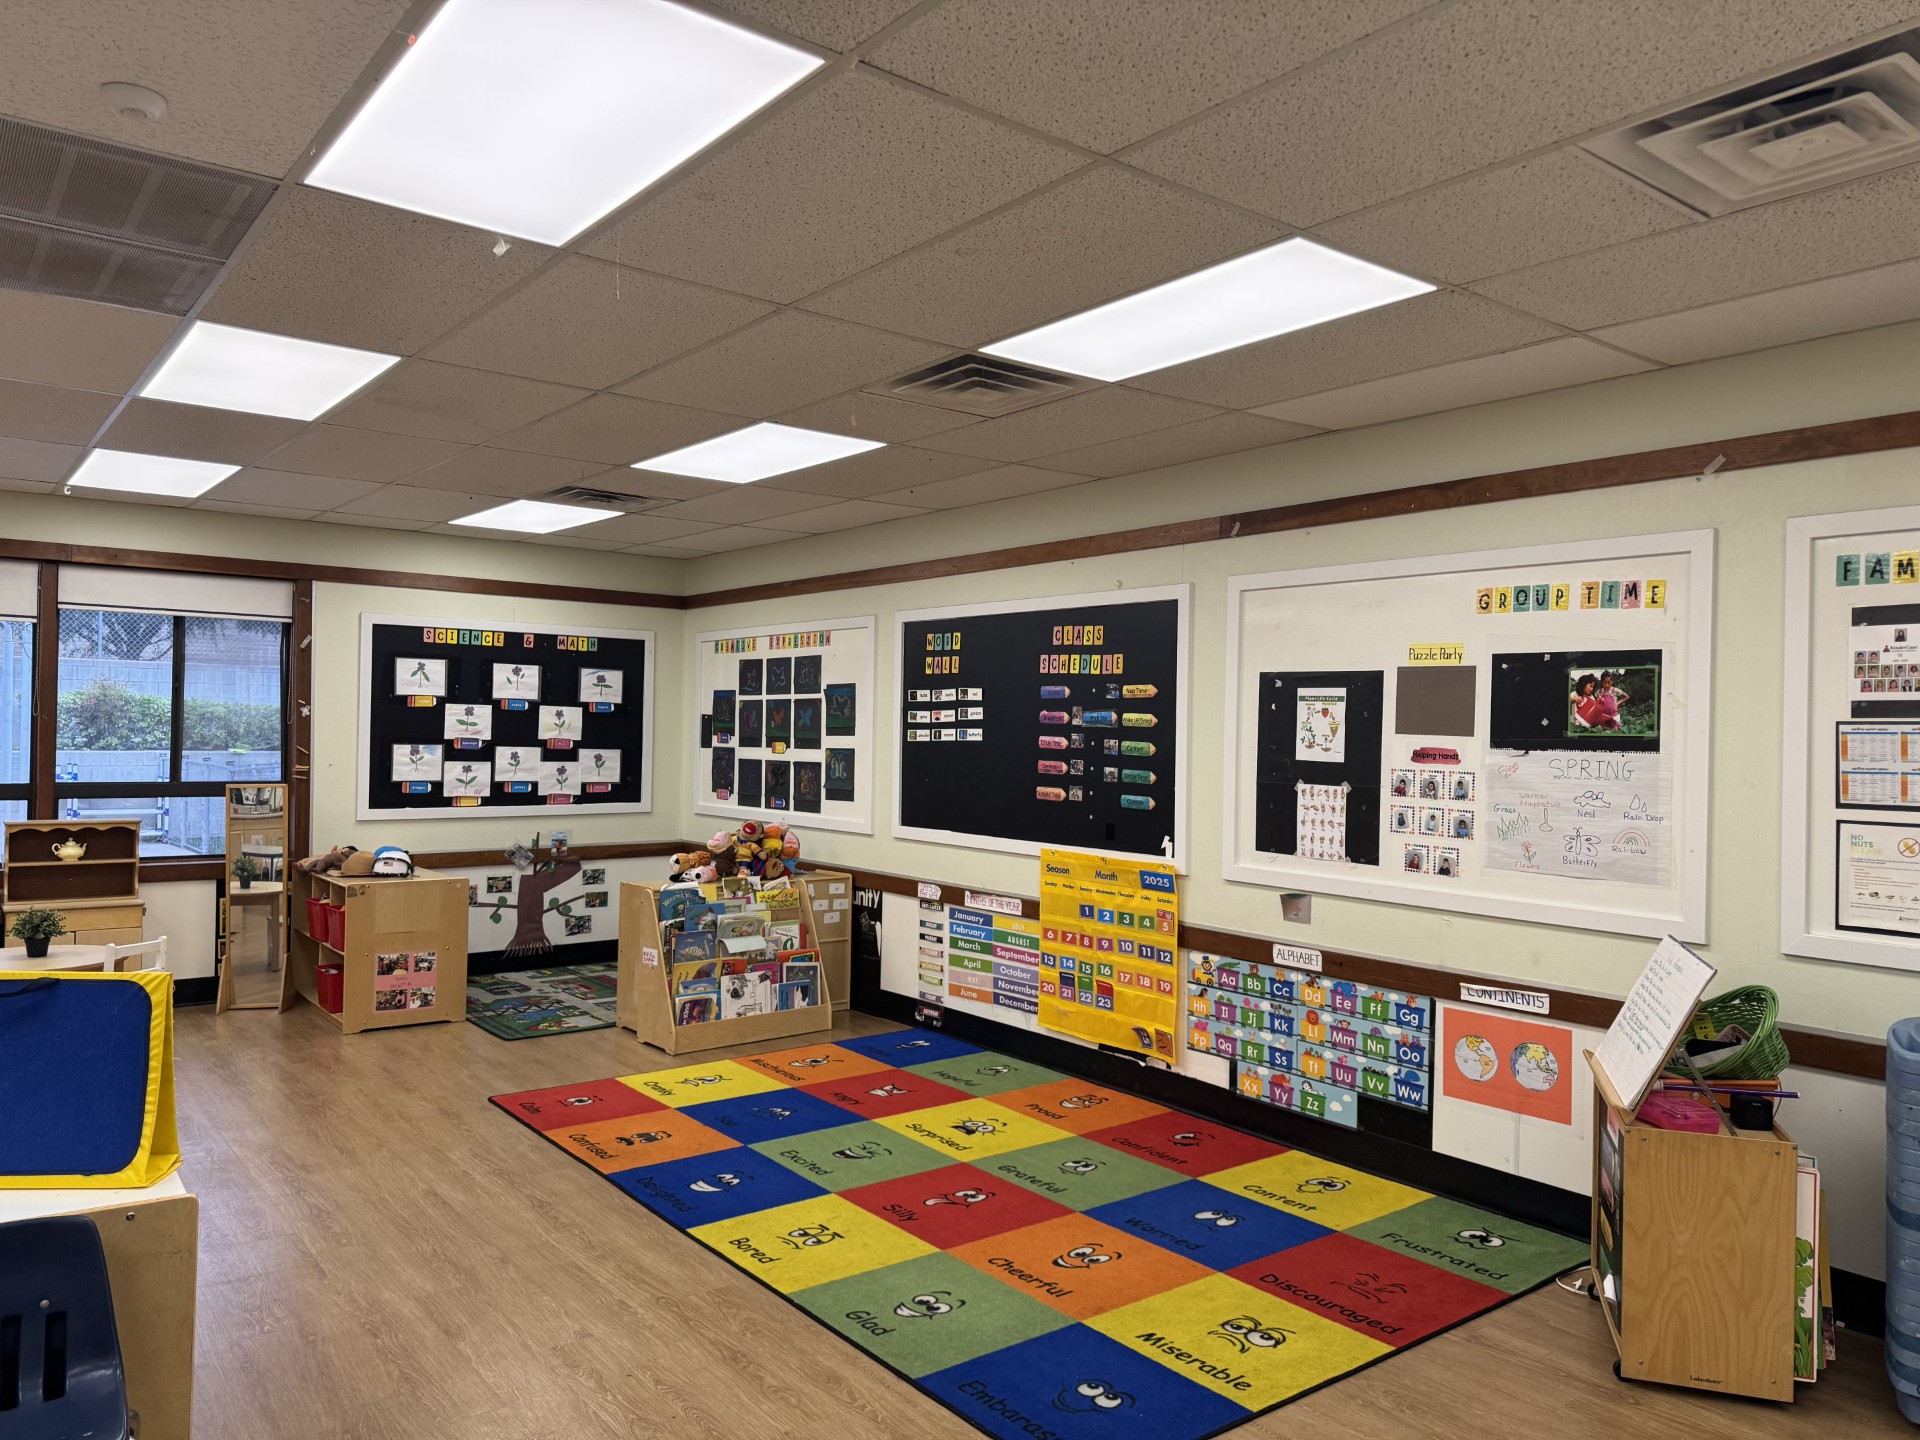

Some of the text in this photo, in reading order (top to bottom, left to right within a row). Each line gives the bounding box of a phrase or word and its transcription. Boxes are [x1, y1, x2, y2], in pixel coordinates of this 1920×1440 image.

[1843, 557, 1915, 581] FAM
[1479, 583, 1658, 610] GROUP TIME
[425, 629, 597, 649] SCIENCE & MATH
[714, 632, 831, 652] CREATIVE EXPRESSION
[927, 634, 960, 647] WORD
[1055, 628, 1102, 642] CLASS
[926, 657, 958, 670] WALL
[1042, 656, 1121, 671] SCHEDULE
[1409, 647, 1463, 664] Puzzle Party
[1126, 687, 1135, 695] Nap
[1413, 750, 1460, 760] Helping Hands
[1549, 758, 1635, 780] SPRING
[1494, 804, 1516, 814] Grass
[1520, 799, 1561, 809] temperature
[1577, 809, 1596, 819] Nest
[1623, 812, 1664, 825] Rain Drop
[1611, 845, 1647, 855] Rainbow
[1562, 855, 1598, 869] Butterfly
[1046, 864, 1170, 888] Season Month 2025
[966, 893, 987, 906] MONTHS
[988, 898, 995, 907] OF
[1005, 901, 1021, 912] YEAR
[1062, 883, 1075, 891] Monday
[1096, 888, 1116, 897] Wednesday
[1118, 891, 1135, 899] Thursday
[1140, 894, 1152, 902] Friday
[1157, 897, 1174, 906] Saturday
[954, 910, 984, 925] January
[1012, 922, 1025, 931] JULY
[1085, 906, 1169, 931] 1 2 3 4 5
[953, 924, 986, 939] February
[1008, 935, 1030, 947] AUGUST
[957, 940, 981, 951] March
[1047, 931, 1171, 962] 6 7 8 9 10 11 12
[963, 958, 982, 969] April
[996, 948, 1040, 964] September
[1276, 948, 1320, 967] ALPHABET
[1000, 966, 1032, 980] October
[1043, 954, 1171, 992] 13 14 15 16 17 18 19
[960, 988, 978, 999] June
[1042, 983, 1111, 1008] 20 21 22 23
[1221, 973, 1419, 1025] Aa Bb Cc Dd Ee Ff Gg
[999, 996, 1039, 1012] December
[1140, 1030, 1150, 1045] 25
[1193, 1000, 1420, 1062] Hh Ii Jj Kk Ll Mm Nn Oo
[748, 1057, 805, 1082] Mischievous
[1194, 1033, 1421, 1101] Pp Qq Rr Ss Tt Uu Vv Ww
[932, 1069, 983, 1088] Hopeful
[643, 1080, 677, 1097] Cranky
[1243, 1079, 1319, 1111] Xx Yy Zz
[518, 1101, 543, 1115] Calm
[829, 1091, 865, 1106] Angry
[1024, 1102, 1066, 1120] Proud
[715, 1115, 738, 1128] Sad
[568, 1132, 620, 1161] Confused
[904, 1122, 974, 1152] Surprised
[1110, 1136, 1189, 1166] Confident
[779, 1148, 835, 1177] Excited
[997, 1164, 1069, 1195] Grateful
[635, 1175, 698, 1214] Delighted
[1242, 1183, 1318, 1213] Content
[881, 1202, 921, 1224] Silly
[1125, 1217, 1208, 1251] Worried
[727, 1236, 782, 1265] Bored
[1379, 1231, 1510, 1281] Frustrated
[987, 1255, 1074, 1299] Cheerful
[1258, 1272, 1406, 1336] Discouraged
[844, 1308, 897, 1338] Glad
[1135, 1332, 1253, 1392] Miserable
